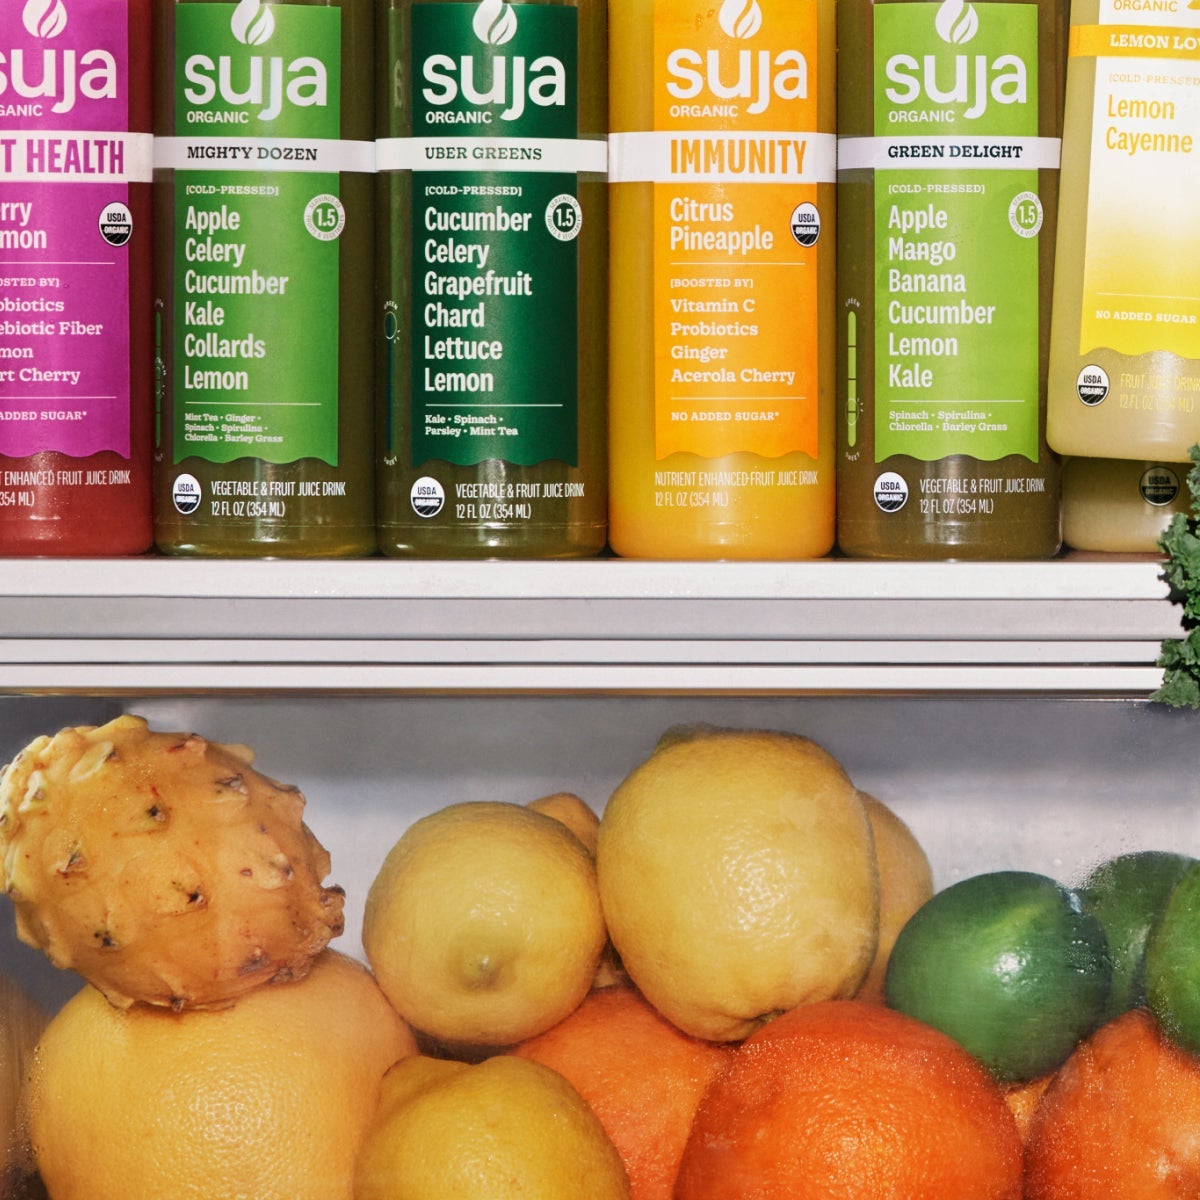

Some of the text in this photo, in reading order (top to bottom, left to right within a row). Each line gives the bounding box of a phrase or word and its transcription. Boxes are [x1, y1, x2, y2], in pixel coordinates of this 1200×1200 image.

[1113, 0, 1178, 13] ORGANIC
[1110, 34, 1169, 49] LEMON
[184, 54, 327, 121] suja
[422, 54, 566, 121] suja
[665, 48, 808, 115] suja
[885, 54, 1027, 120] suja
[669, 104, 738, 118] ORGANIC
[1107, 94, 1175, 120] Lemon
[187, 110, 249, 124] ORGANIC
[425, 110, 492, 124] ORGANIC
[888, 110, 956, 123] ORGANIC
[1106, 126, 1193, 156] Cayenne
[26, 139, 124, 174] HEALTH
[187, 146, 318, 161] MIGHTY DOZEN
[424, 147, 542, 160] UBER GREENS
[670, 139, 807, 174] IMMUNITY
[888, 145, 1024, 159] GREEN DELIGHT
[425, 186, 522, 197] [COLD-PRESSED]
[888, 184, 985, 195] [COLD-PRESSED]
[107, 212, 126, 222] USDA
[316, 208, 336, 227] 1.5
[556, 208, 574, 227] 1.5
[670, 197, 734, 222] Citrus
[1018, 205, 1036, 224] 1.5
[185, 204, 240, 235] Apple
[424, 206, 532, 232] Cucumber
[798, 213, 816, 224] USDA
[888, 204, 948, 234] Apple
[104, 226, 129, 234] ORGANIC
[795, 226, 818, 235] ORGANIC
[670, 224, 774, 256] Pineapple
[185, 236, 246, 268] Celery
[424, 238, 490, 270] Celery
[888, 236, 956, 266] Mango
[184, 269, 289, 294] Cucumber
[424, 270, 533, 301] Grapefruit
[888, 268, 966, 294] Banana
[184, 300, 225, 326] Kale
[670, 298, 756, 313] Vitamin C
[888, 299, 996, 325] Cucumber
[424, 302, 485, 328] Chard
[1096, 310, 1198, 325] NO ADDED SUGAR
[670, 322, 758, 336] Probiotics
[184, 332, 266, 358] Collards
[424, 335, 503, 360] Lettuce
[888, 332, 958, 357] Lemon
[670, 345, 728, 363] Ginger
[184, 365, 249, 390] Lemon
[424, 367, 494, 392] Lemon
[670, 368, 795, 386] Acerola Cherry
[888, 362, 934, 388] Kale
[1083, 374, 1102, 384] USDA
[1080, 387, 1104, 396] ORGANIC
[424, 414, 497, 426] Kale Spinach
[671, 412, 688, 422] NO
[691, 412, 732, 422] ADDED
[889, 410, 986, 422] Spinach Spirulina
[424, 426, 518, 438] Parsley Mint Tea
[889, 422, 1008, 434] Chlorella Barley Grass
[4, 470, 55, 486] ENHANCED
[57, 470, 83, 486] FRUIT
[84, 470, 108, 486] JUICE
[108, 470, 131, 485] DRINK
[655, 470, 819, 487] NUTRIENT ENHANCED FRUIT JUICE DRINK
[880, 482, 901, 491] USDA
[920, 478, 1045, 494] VEGETABLE & FRUIT JUICE DRINK
[1148, 476, 1171, 485] USDA
[178, 483, 194, 492] USDA
[211, 480, 346, 496] VEGETABLE & FRUIT JUICE DRINK
[418, 486, 436, 496] USDA
[456, 482, 584, 498] VEGETABLE & FRUIT JUICE DRINK
[655, 491, 729, 508] 12 FL OZ (354 ML)
[878, 494, 904, 502] ORGANIC
[920, 498, 994, 515] 12 FL OZ (354 ML)
[211, 500, 286, 518] 12 FL OZ (354 ML)
[456, 504, 532, 520] 12 FL OZ (354 ML)
